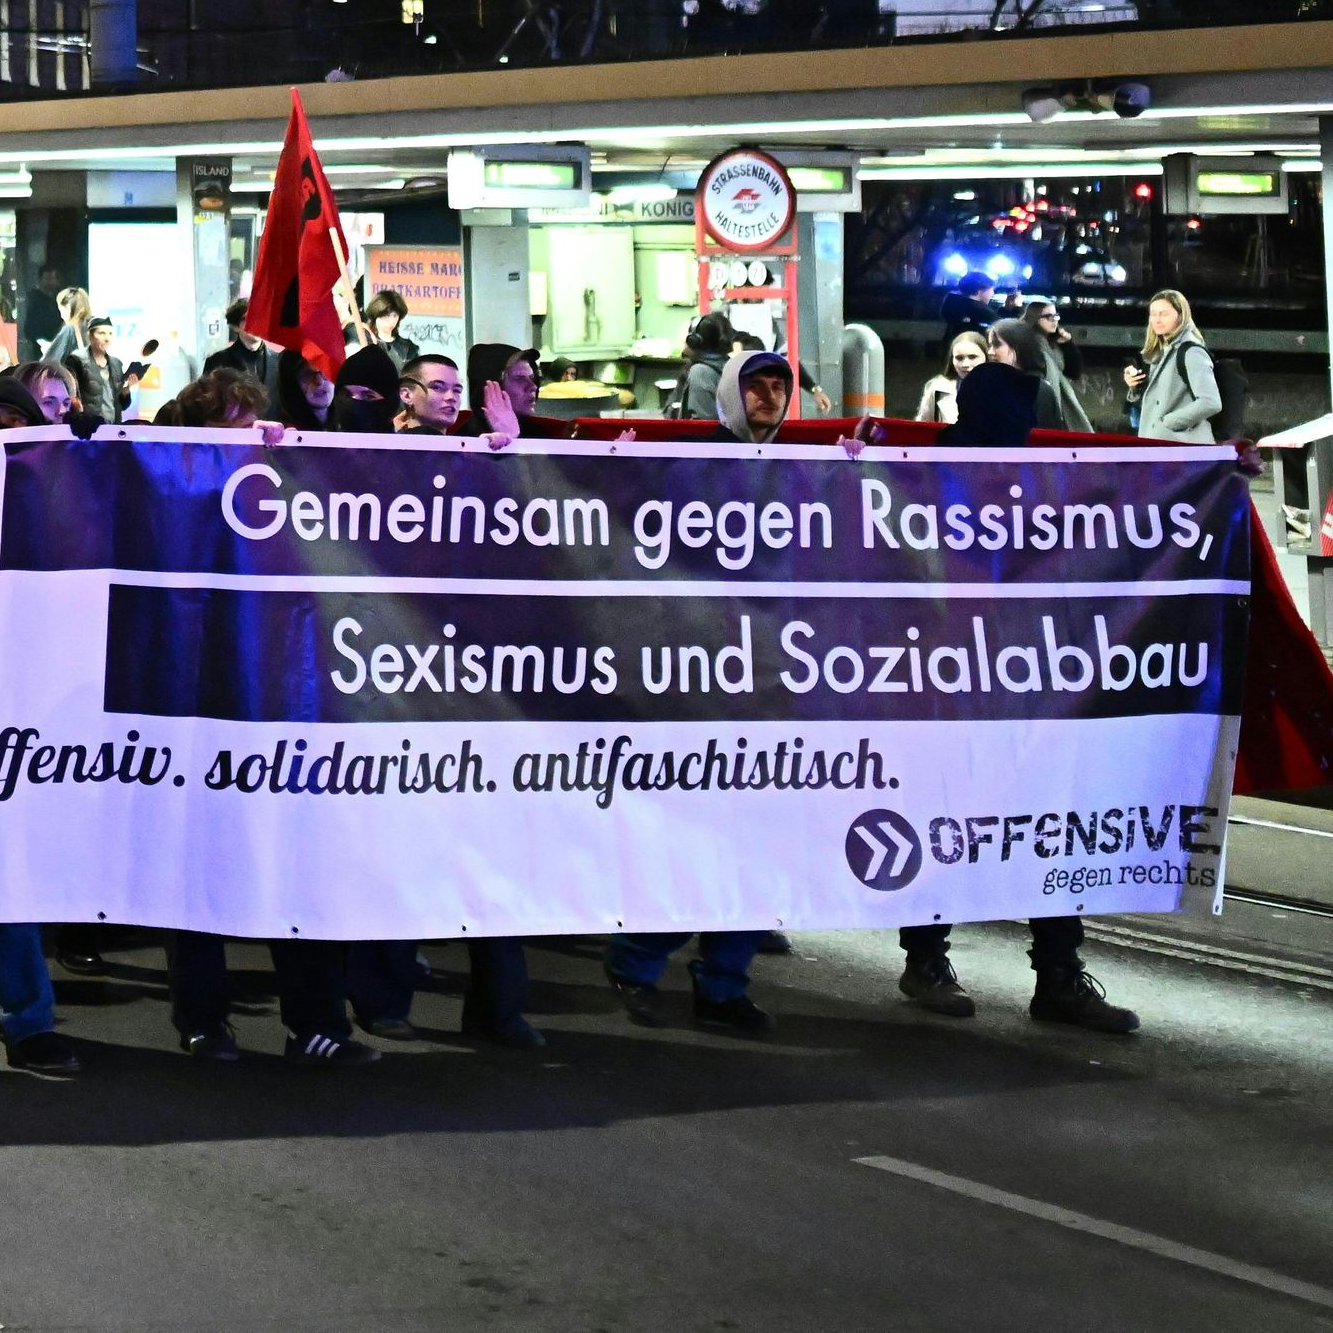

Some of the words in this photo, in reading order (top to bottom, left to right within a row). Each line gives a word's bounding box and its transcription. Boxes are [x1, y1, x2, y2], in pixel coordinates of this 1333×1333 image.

[711, 164, 782, 196] STRASSENBAHN
[714, 210, 779, 239] HALTESTELLE
[379, 261, 424, 275] HEISSE
[221, 463, 609, 546] Gemeinsam
[635, 498, 833, 570] gegen
[862, 479, 1214, 561] Rassismus,
[331, 617, 617, 694] Sexismus
[641, 615, 754, 694] und
[780, 615, 1208, 694] Sozialabbau
[205, 739, 497, 795] solidarisch.
[512, 736, 900, 809] antifaschistisch.
[1043, 868, 1112, 895] gegen
[1118, 860, 1216, 887] rechts
